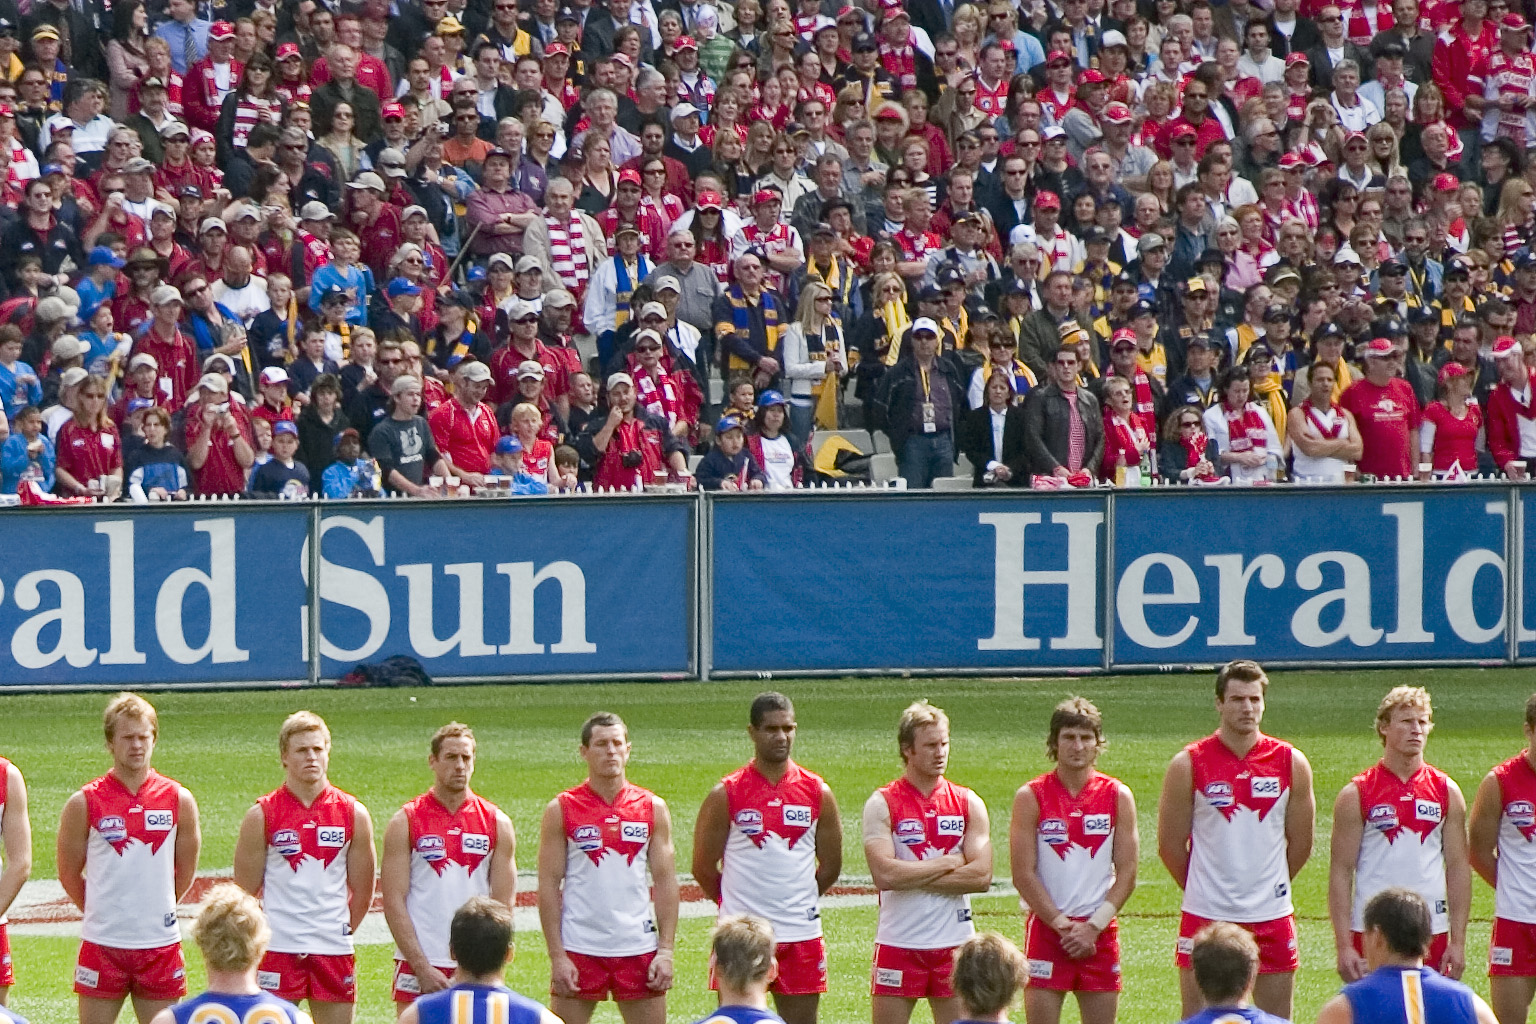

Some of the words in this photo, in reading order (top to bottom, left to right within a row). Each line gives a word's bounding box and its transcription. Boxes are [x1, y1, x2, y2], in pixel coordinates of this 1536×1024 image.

[978, 502, 1536, 651] Herald
[300, 515, 597, 661] Sun
[785, 809, 810, 822] QBE
[1418, 804, 1440, 818] QBE
[147, 813, 171, 825] QBE
[1086, 819, 1109, 831] QBE
[624, 826, 648, 838] QBE
[940, 820, 963, 832] QBE
[320, 831, 344, 842] QBE
[464, 838, 489, 850] QBE
